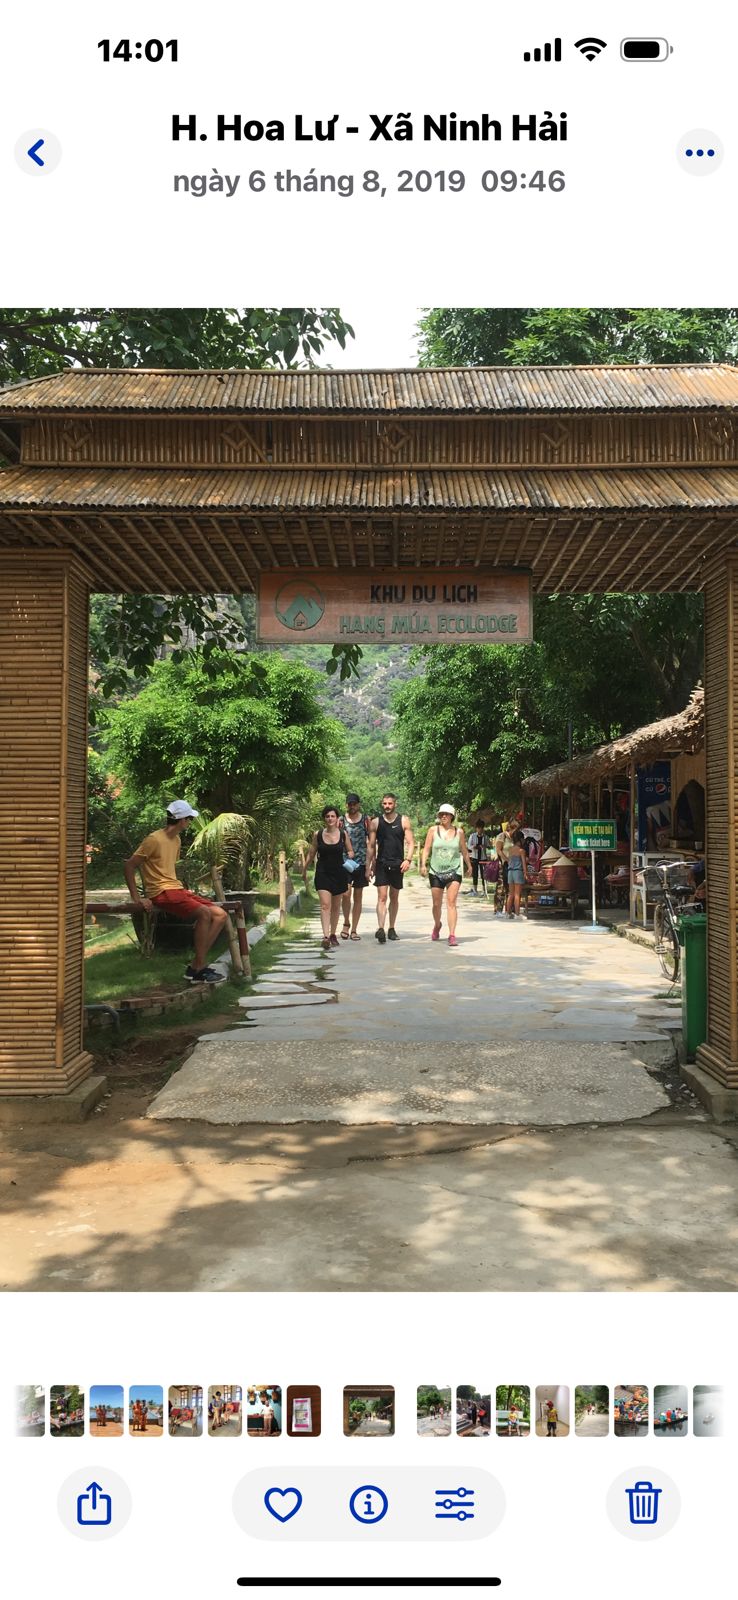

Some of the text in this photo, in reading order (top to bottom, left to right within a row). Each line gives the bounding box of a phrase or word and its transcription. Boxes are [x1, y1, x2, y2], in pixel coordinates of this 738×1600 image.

[370, 584, 405, 603] KHU
[412, 584, 436, 603] DU
[339, 610, 518, 634] HANG MÚA ECOLODGE
